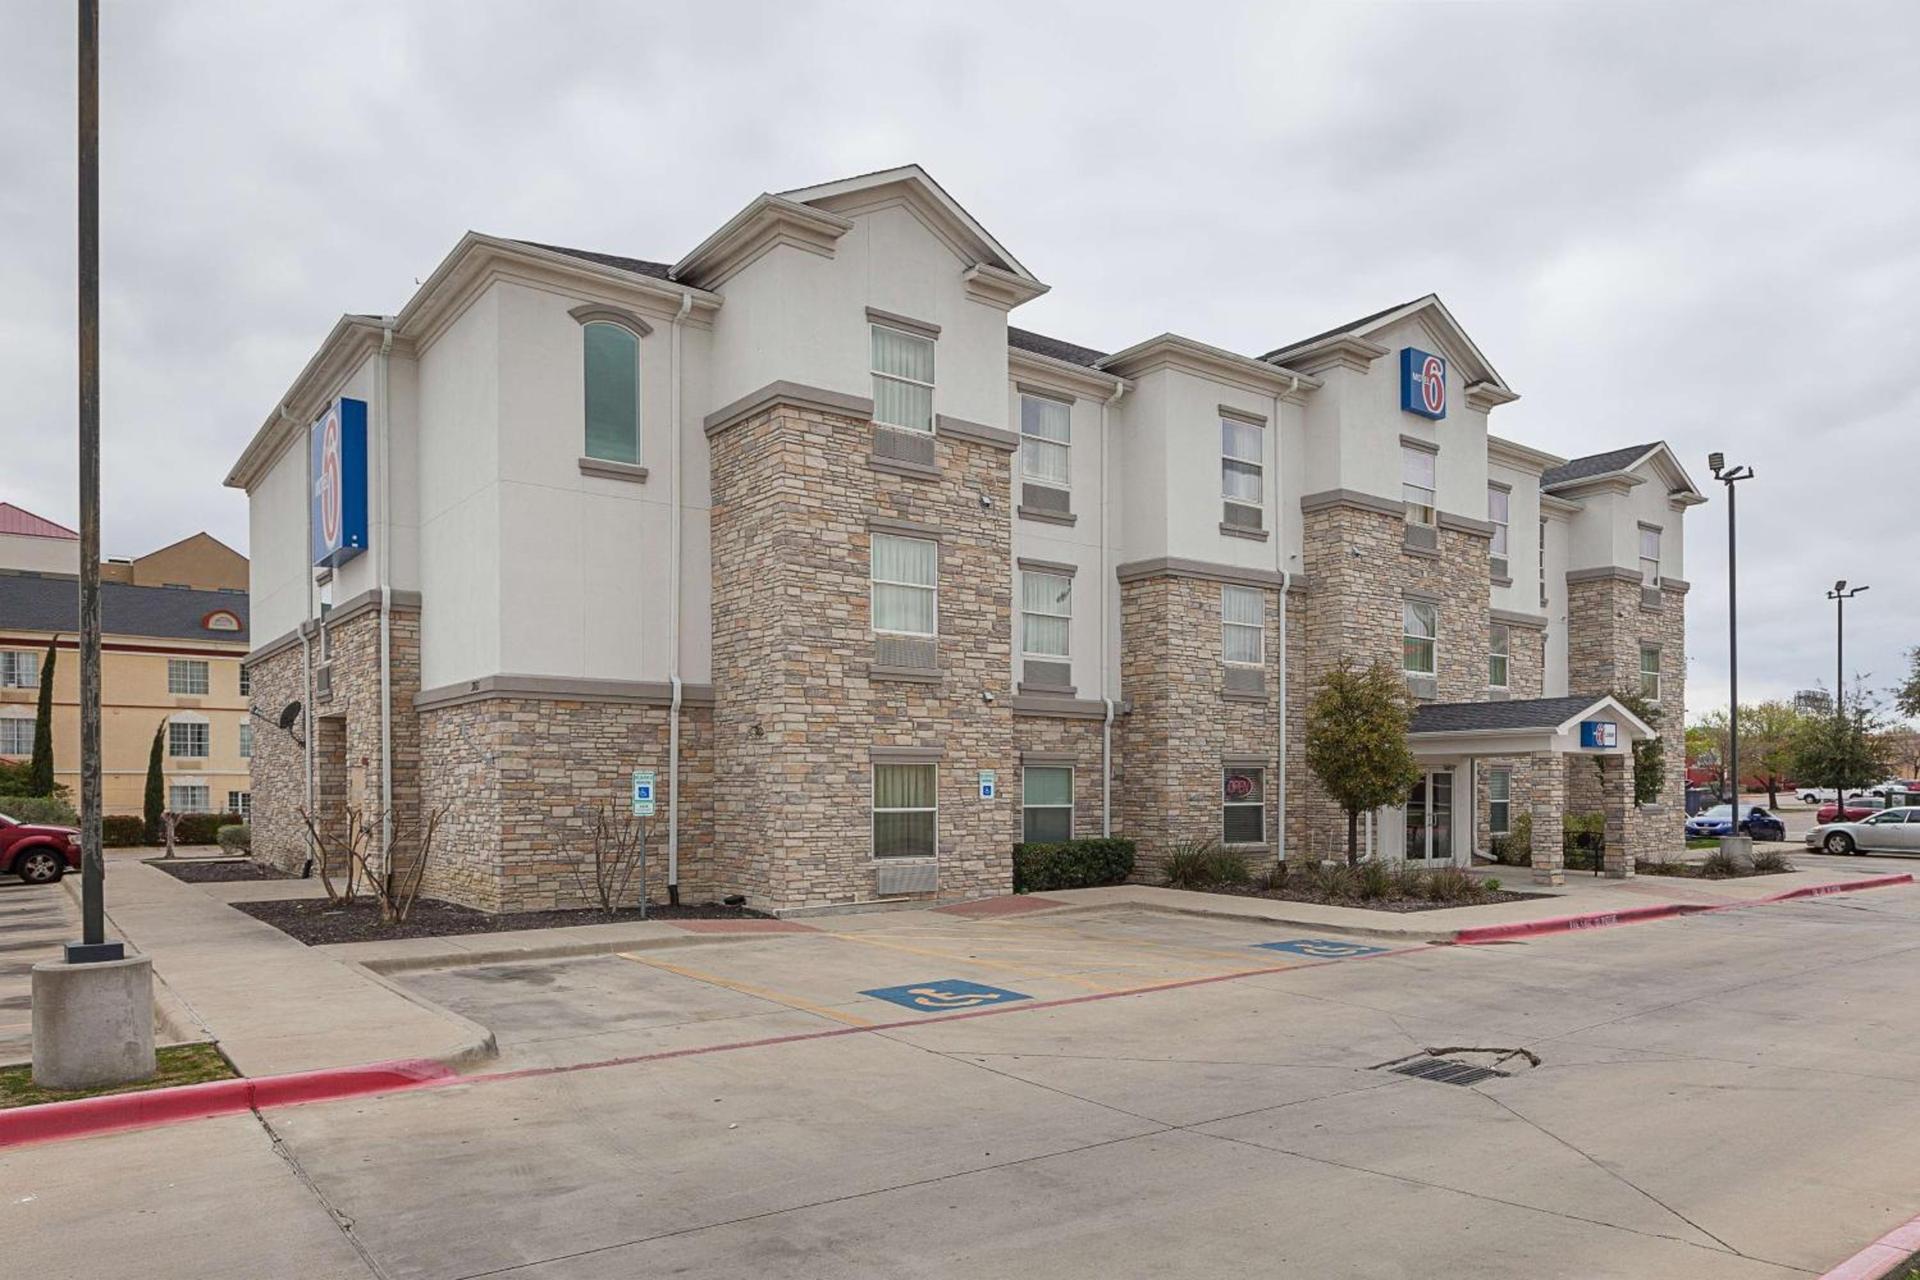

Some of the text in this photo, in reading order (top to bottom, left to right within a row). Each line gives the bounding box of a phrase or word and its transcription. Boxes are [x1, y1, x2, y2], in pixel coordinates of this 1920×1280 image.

[1423, 357, 1444, 413] 6
[322, 415, 340, 550] 6
[1228, 780, 1250, 793] OPEN
